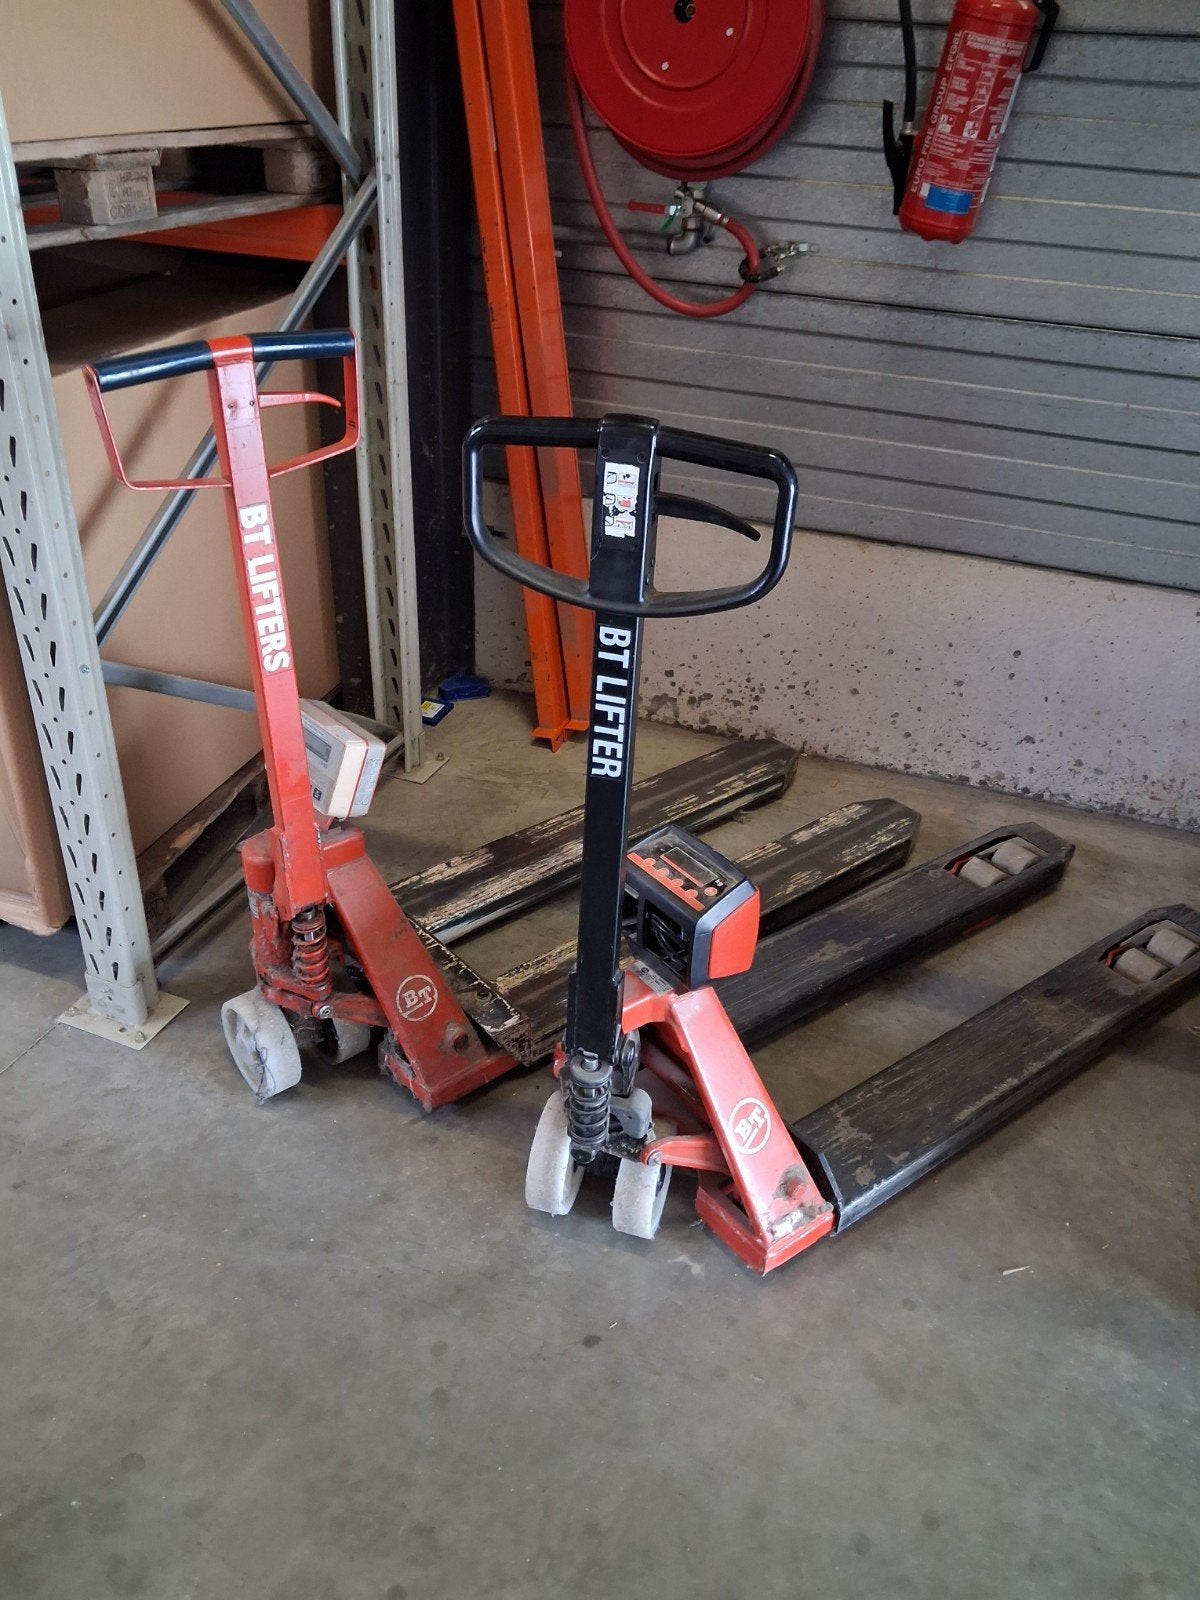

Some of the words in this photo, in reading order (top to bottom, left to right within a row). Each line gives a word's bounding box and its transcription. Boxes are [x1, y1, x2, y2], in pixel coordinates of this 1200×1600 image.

[911, 158, 925, 192] EURO
[921, 127, 934, 155] FIRE
[930, 77, 948, 124] GROUP
[239, 504, 273, 545] BT
[247, 554, 290, 672] LIFTERS
[597, 625, 631, 669] BT
[591, 675, 628, 778] LIFTER
[401, 985, 433, 1009] BT
[733, 1105, 766, 1141] BT
